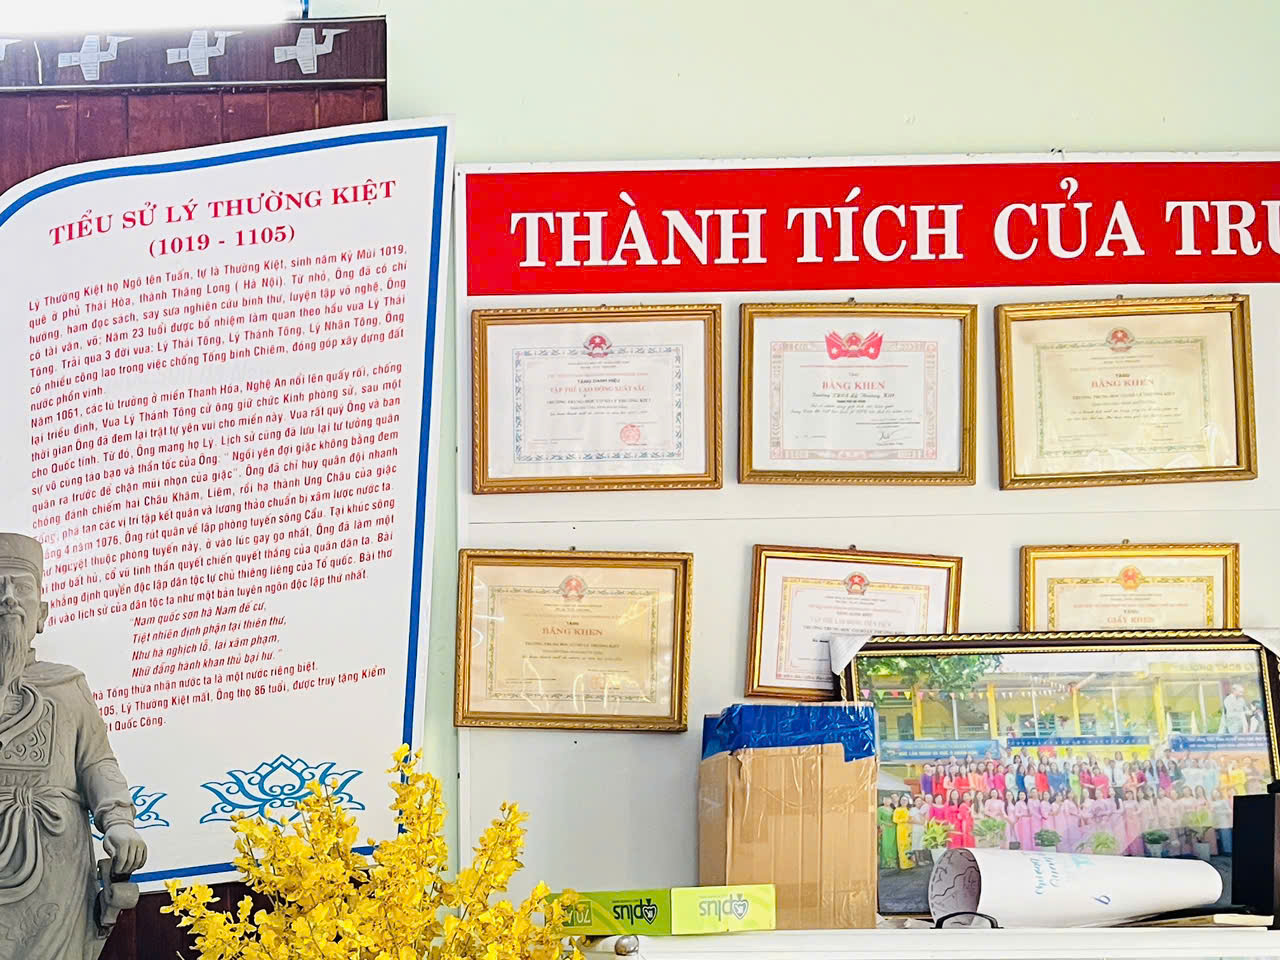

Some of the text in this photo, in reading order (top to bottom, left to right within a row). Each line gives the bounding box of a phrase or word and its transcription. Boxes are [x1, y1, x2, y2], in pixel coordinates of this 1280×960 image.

[49, 178, 397, 246] TIỂU SỬ LÝ THƯỜNG KIỆT
[510, 192, 767, 268] THÀNH
[786, 186, 963, 263] TÍCH
[994, 177, 1145, 260] CỦA
[149, 233, 210, 258] (1019
[236, 224, 296, 248] 1105)
[83, 282, 104, 297] Kiệt
[106, 281, 119, 293] họ
[122, 275, 143, 291] Ngô
[145, 273, 162, 286] tên
[197, 267, 207, 280] tự
[210, 264, 220, 277] là
[223, 262, 261, 276] Thường
[290, 255, 312, 268] sinh
[61, 354, 81, 369] Trải
[83, 353, 102, 367] qua
[104, 349, 112, 361] 3
[114, 346, 130, 360] đời
[157, 340, 169, 353] Lý
[171, 336, 194, 350] Thái
[228, 331, 241, 345] Lý
[243, 327, 275, 341] Thánh
[309, 321, 321, 336] Lý
[324, 318, 351, 332] Nhân
[385, 309, 405, 324] Ông
[854, 379, 885, 390] KHEN
[151, 627, 179, 641] nhiên
[180, 624, 202, 639] định
[202, 621, 227, 637] phận
[227, 619, 242, 633] tại
[242, 616, 268, 630] thiên
[157, 608, 181, 626] quốc
[181, 608, 200, 621] sơn
[200, 606, 213, 618] hà
[214, 605, 238, 617] Nam
[574, 627, 603, 636] KHEN
[131, 649, 152, 662] Như
[151, 646, 165, 659] hà
[165, 641, 198, 658] nghịch
[214, 639, 227, 651] lai
[227, 636, 249, 649] xâm
[613, 898, 644, 925] plus
[699, 893, 733, 921] plus
